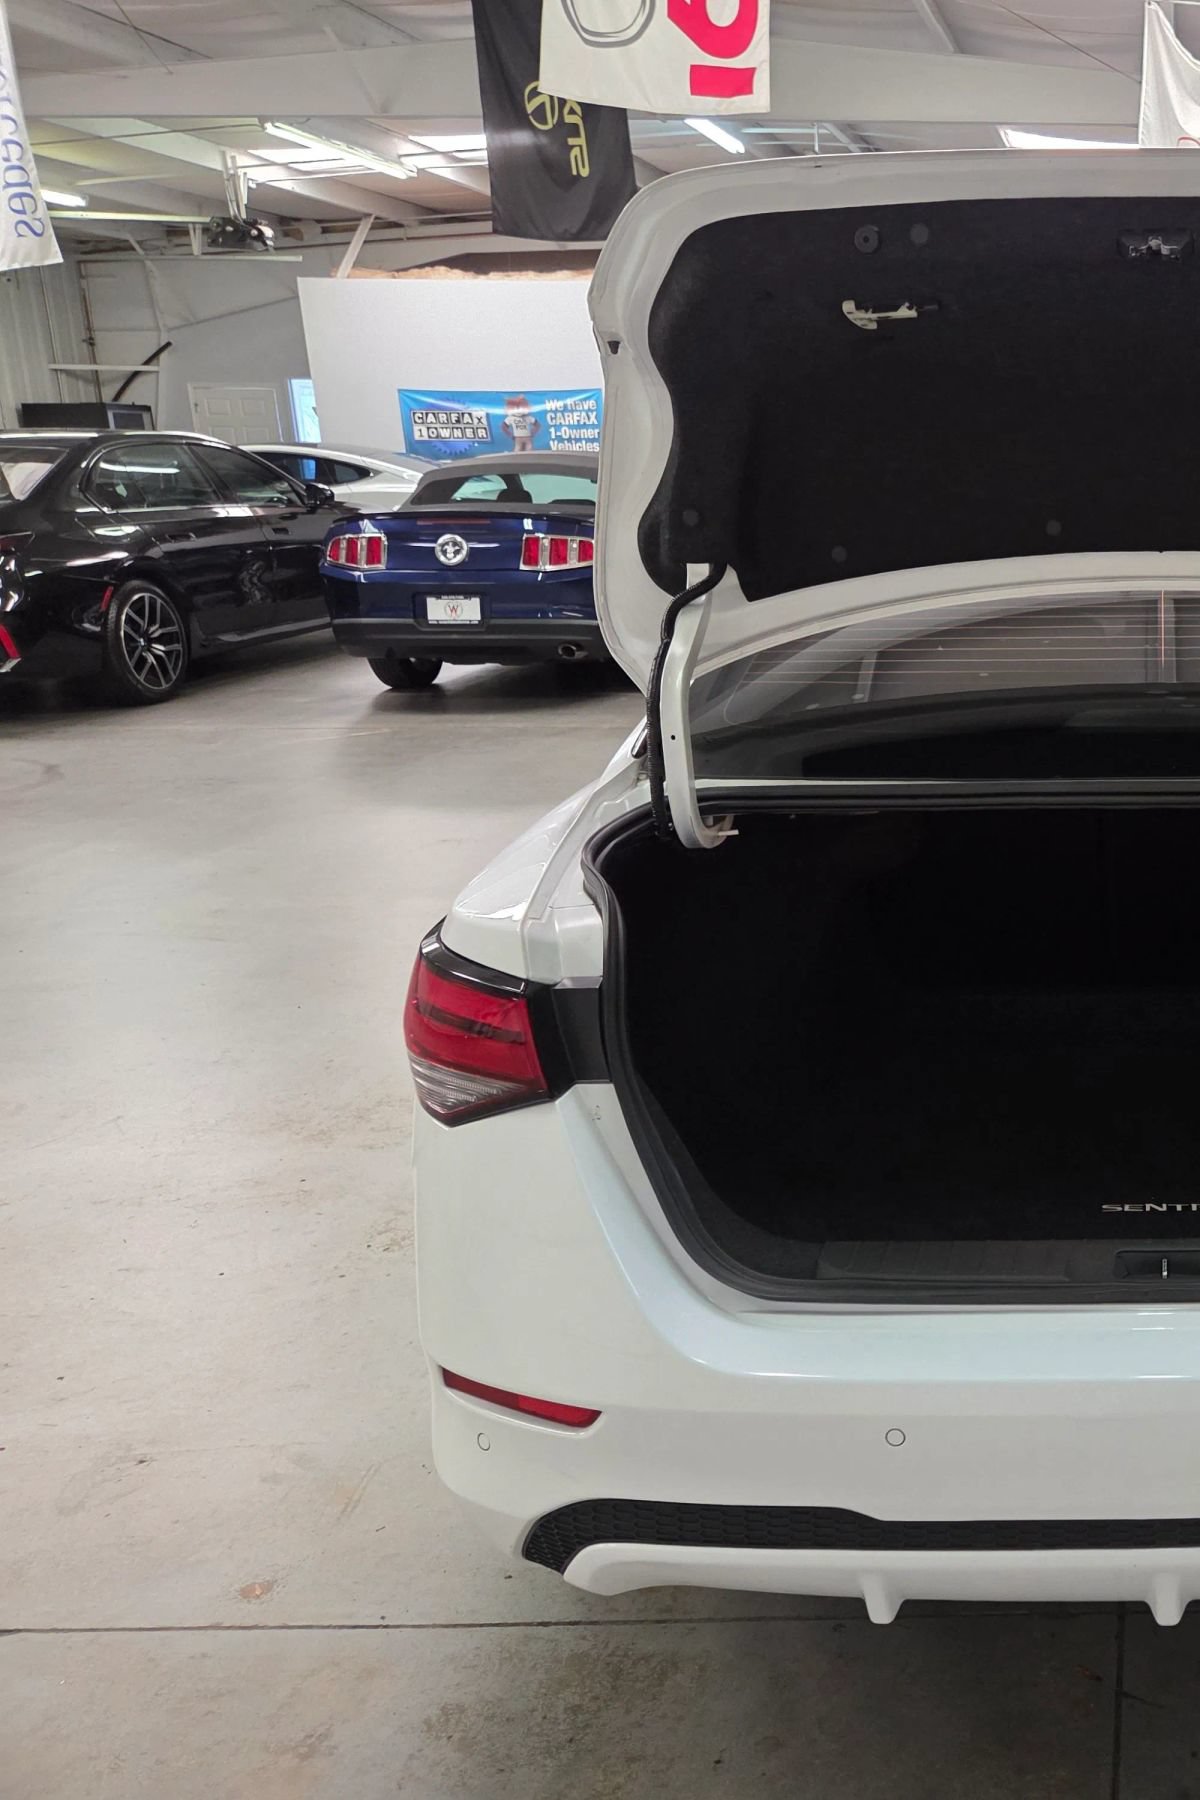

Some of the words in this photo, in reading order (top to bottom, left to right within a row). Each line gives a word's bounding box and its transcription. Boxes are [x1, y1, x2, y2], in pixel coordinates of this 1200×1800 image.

[545, 399, 564, 410] We
[412, 412, 486, 425] CARFAX
[546, 411, 598, 425] CARFAX
[549, 426, 599, 439] 1-Owner
[549, 440, 600, 452] Vehicles
